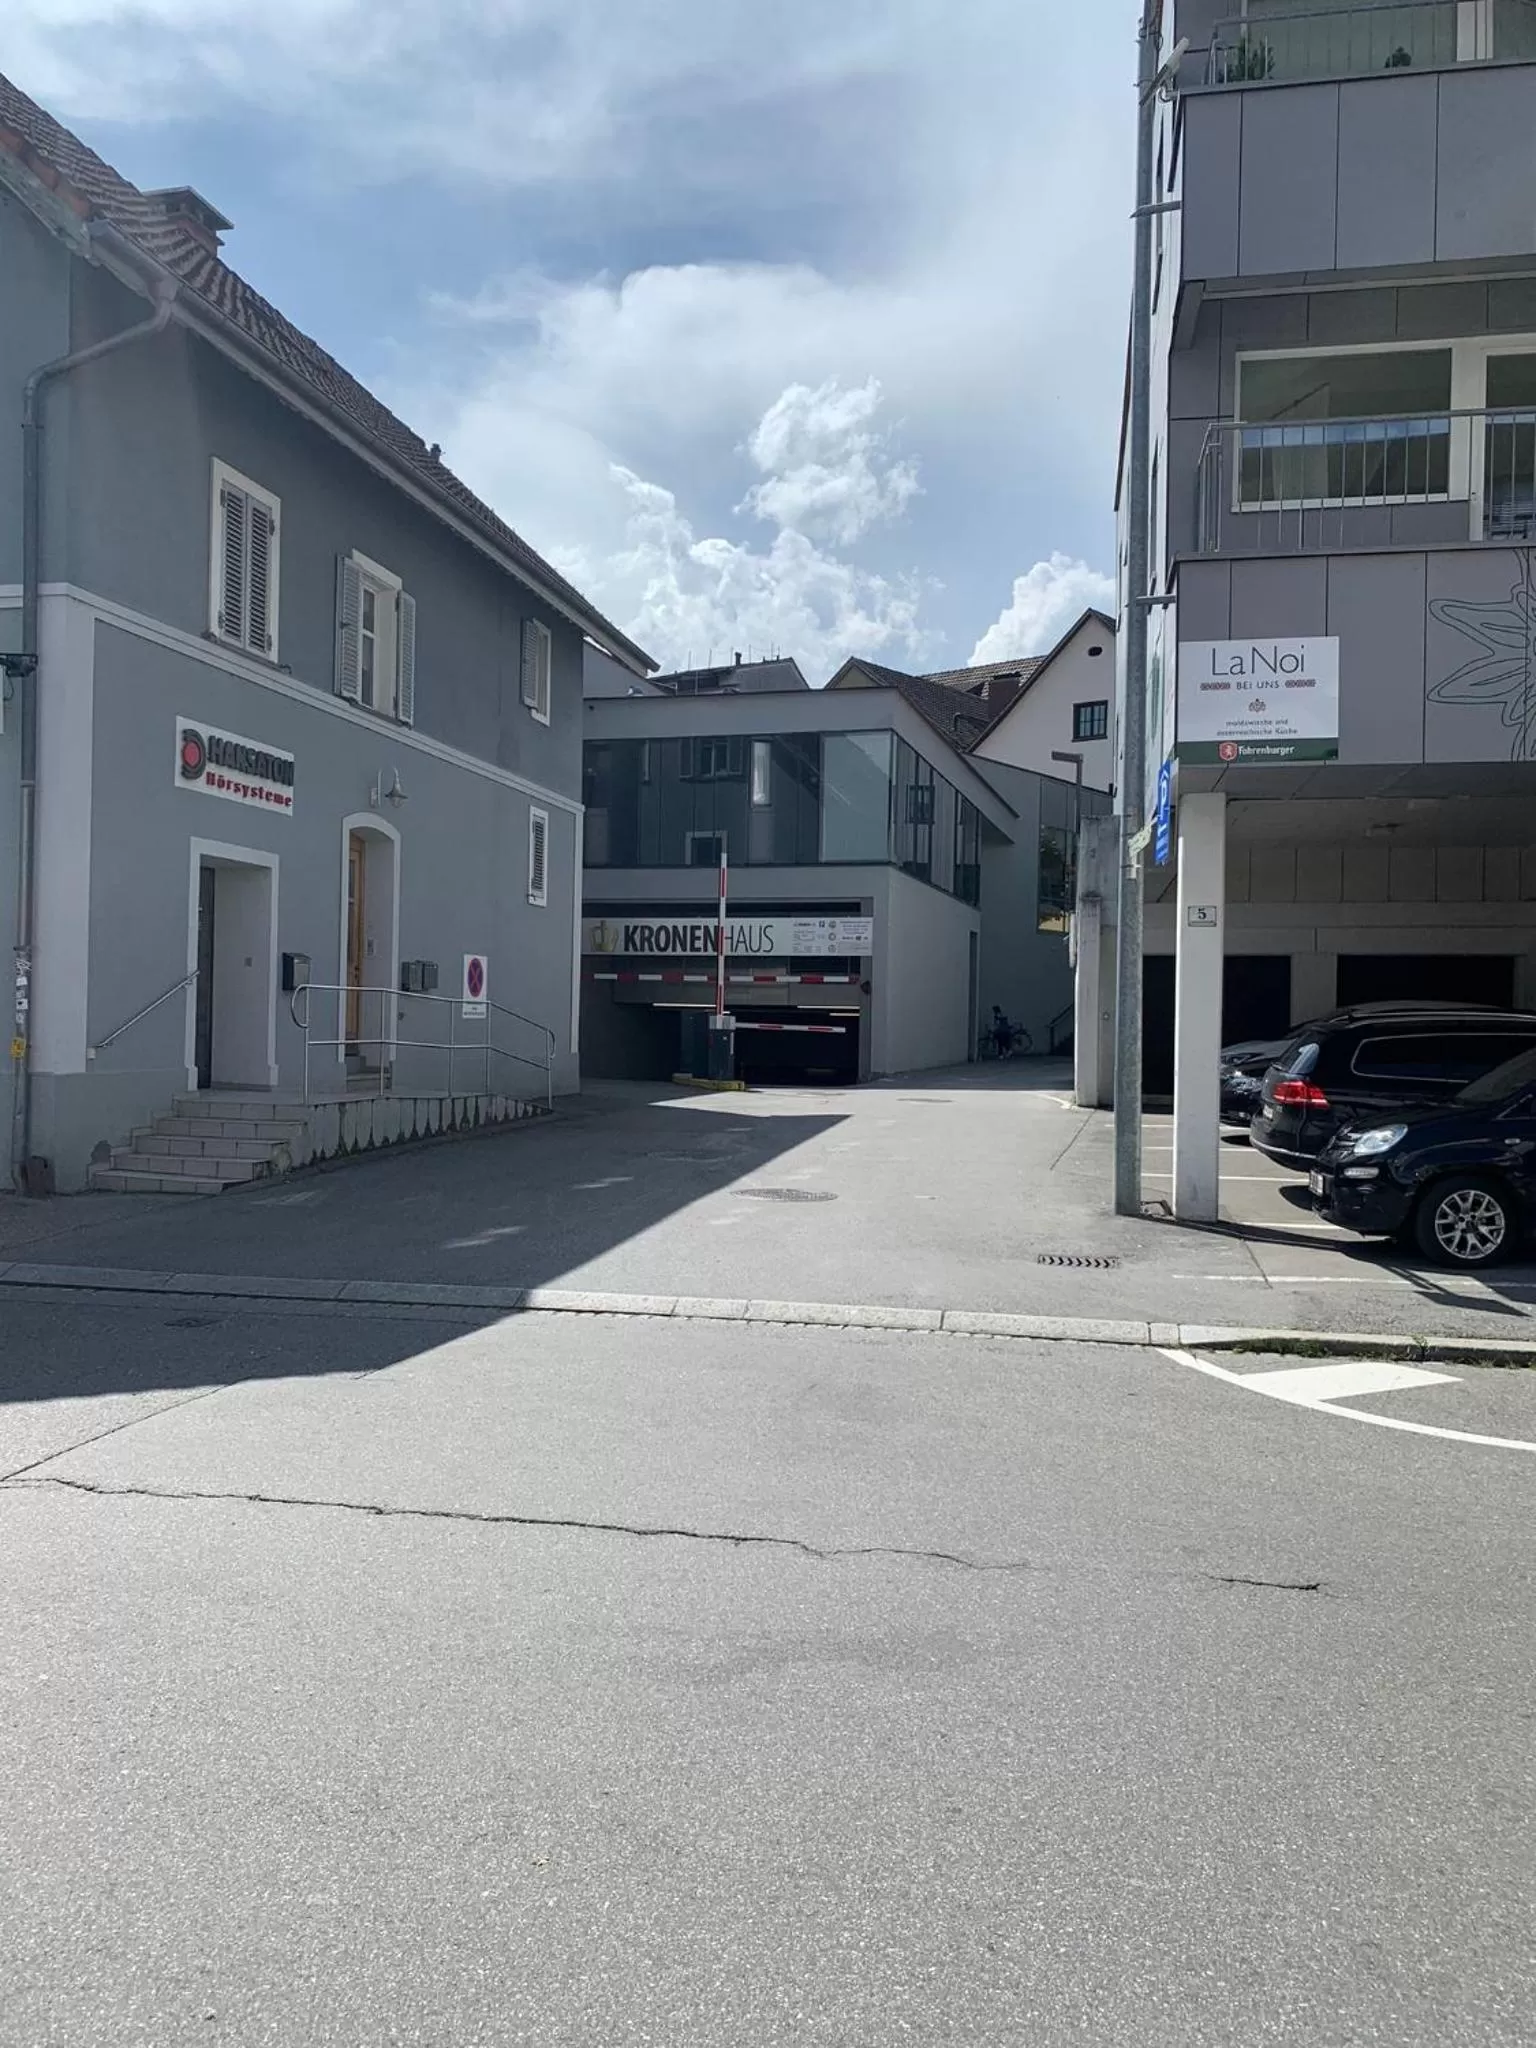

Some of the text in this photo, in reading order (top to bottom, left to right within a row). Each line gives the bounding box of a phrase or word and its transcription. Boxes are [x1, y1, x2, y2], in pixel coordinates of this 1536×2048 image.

[1236, 679, 1280, 690] BEI UNS
[205, 771, 293, 807] Hörsysteme
[1198, 907, 1207, 920] 5
